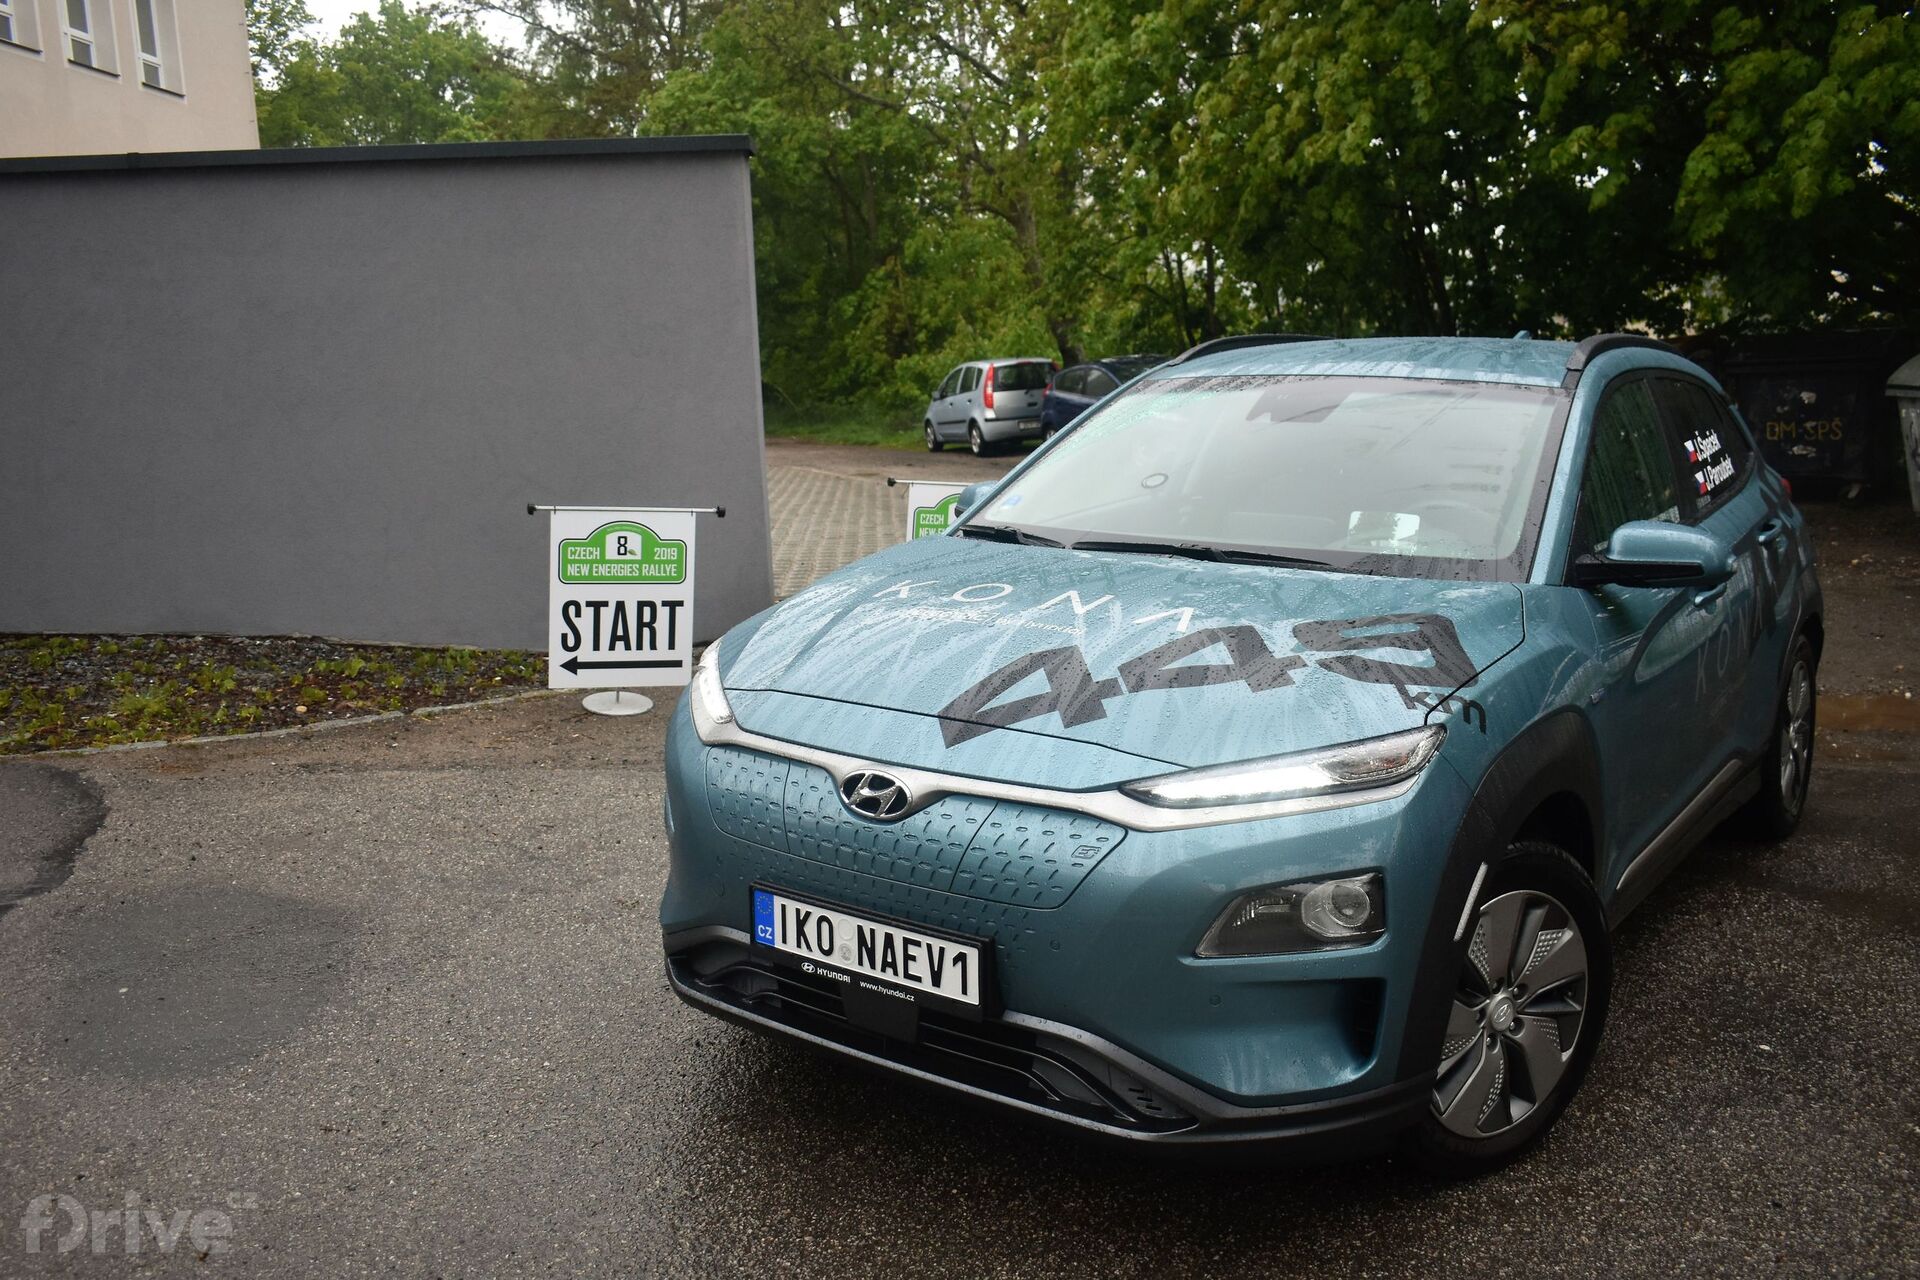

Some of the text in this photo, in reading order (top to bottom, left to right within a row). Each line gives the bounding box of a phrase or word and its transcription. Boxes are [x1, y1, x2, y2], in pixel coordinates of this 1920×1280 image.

[920, 513, 944, 524] CZECH
[567, 547, 678, 560] CZECH 2019
[617, 535, 628, 556] 8
[567, 563, 678, 577] NEW ENERGIES RALLYE
[560, 599, 685, 653] START
[936, 612, 1479, 749] 449
[757, 924, 773, 941] CZ
[856, 923, 968, 997] NAEV1
[817, 967, 915, 1002] HYUNDAI www.hyundai.cz
